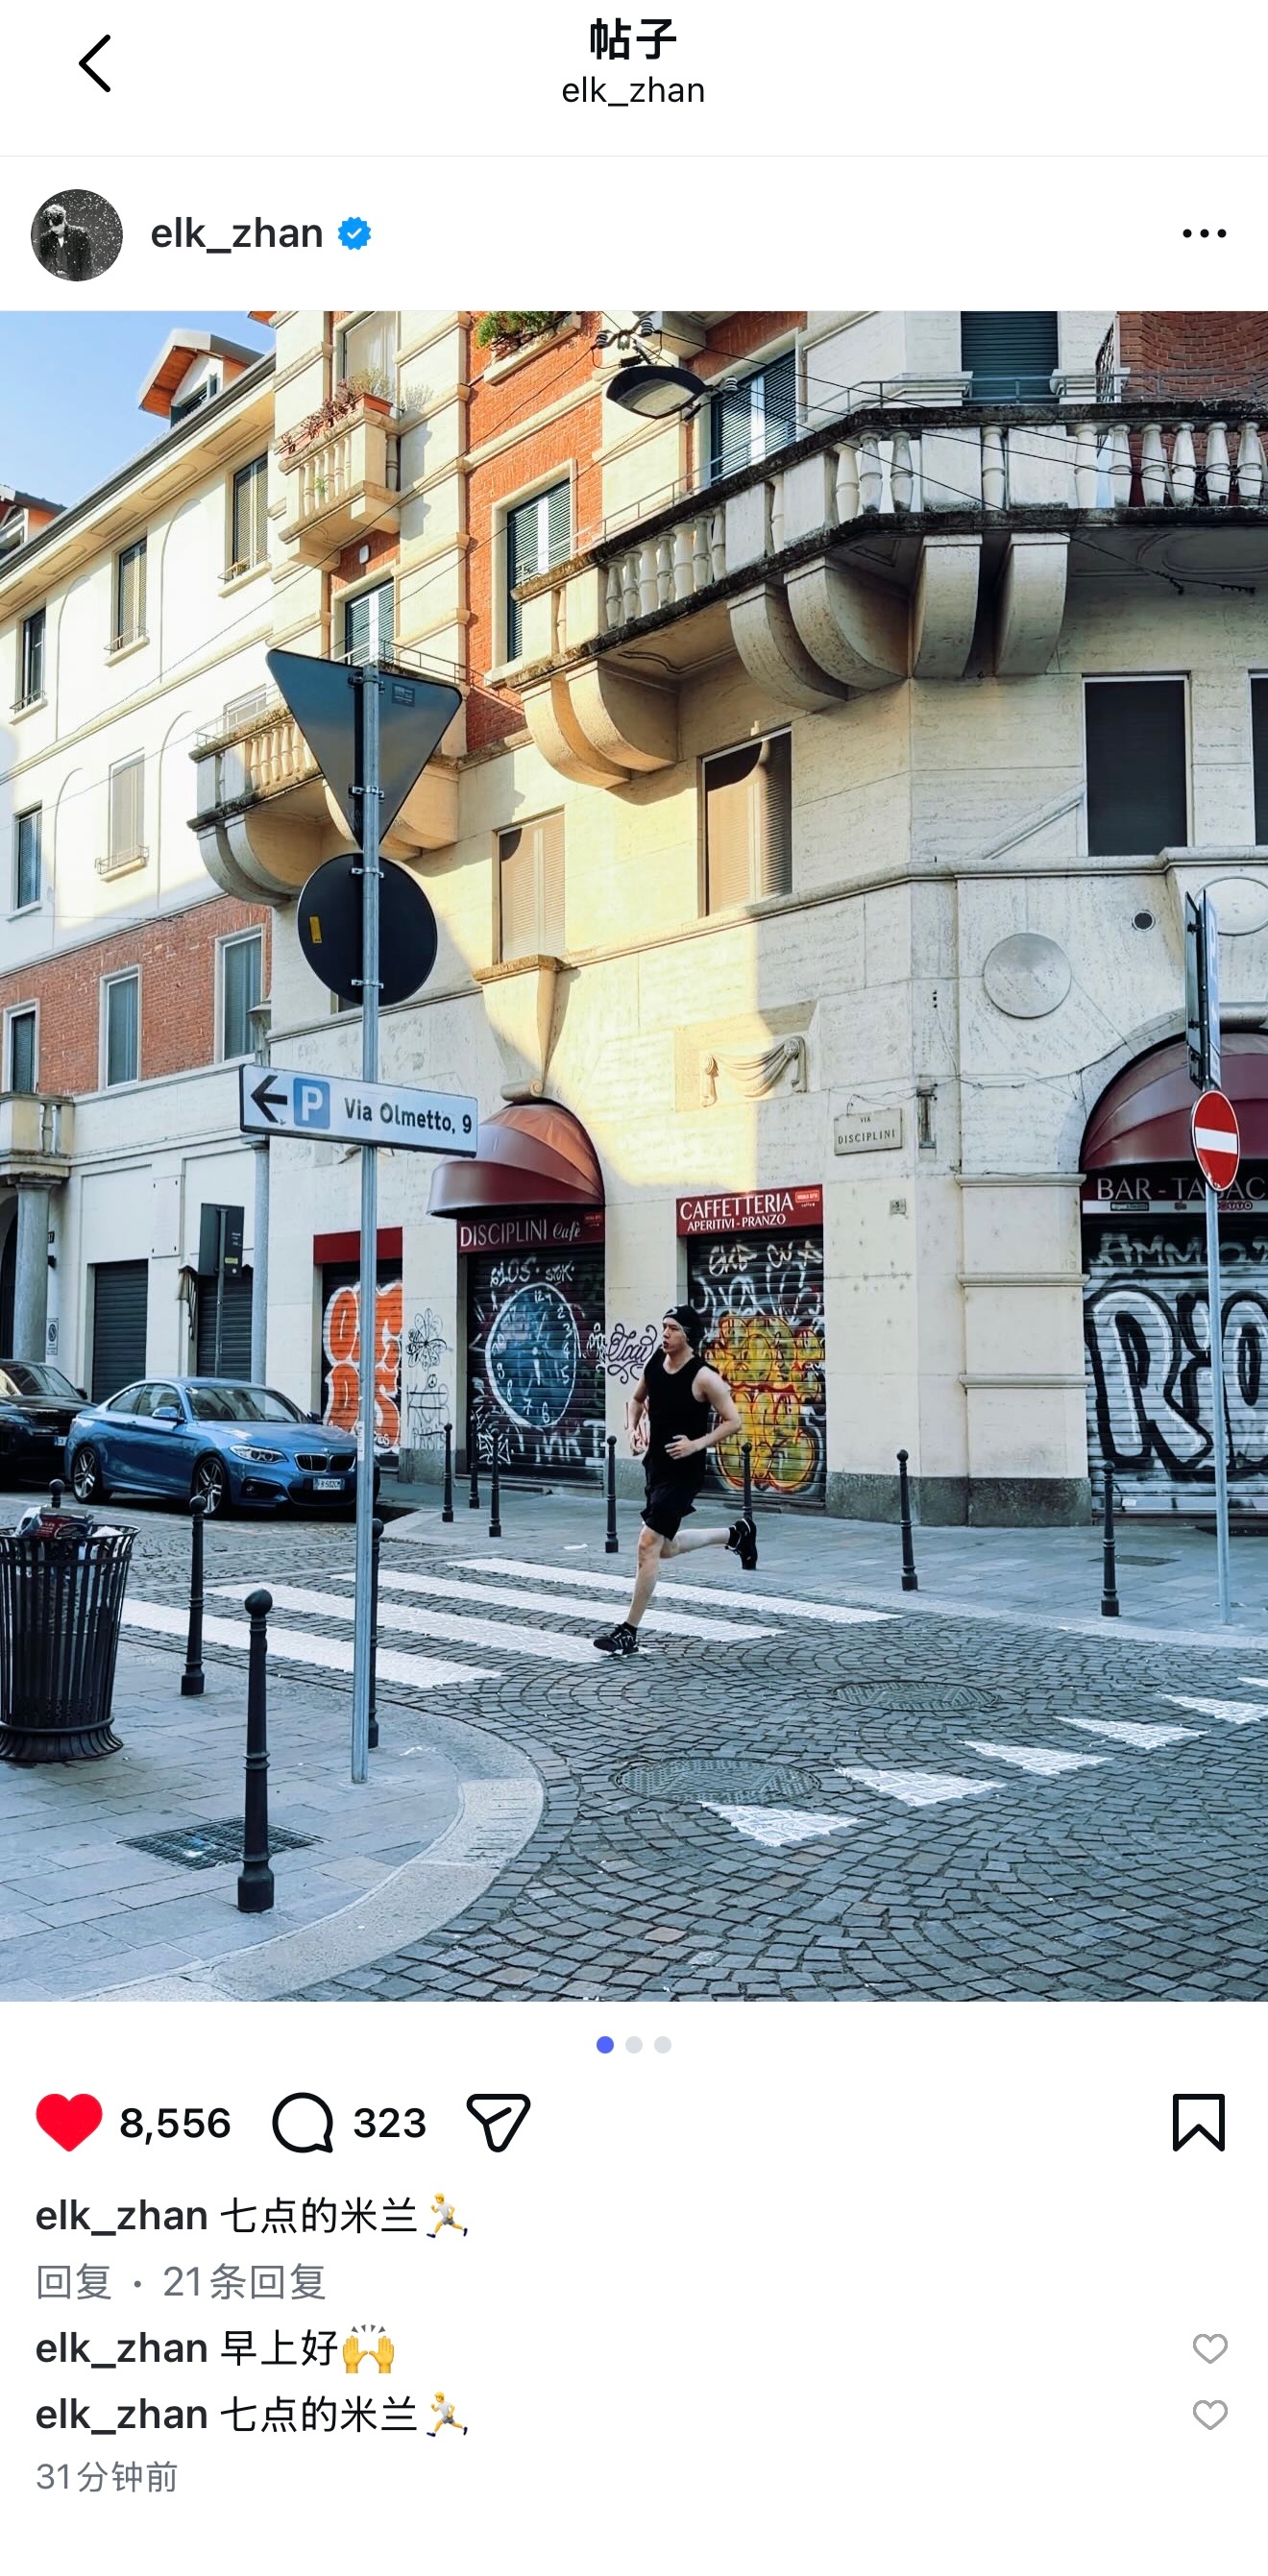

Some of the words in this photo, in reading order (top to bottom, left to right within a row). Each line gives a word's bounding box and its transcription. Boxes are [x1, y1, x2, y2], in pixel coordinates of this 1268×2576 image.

[302, 1086, 323, 1122] P
[345, 1098, 373, 1122] Via
[379, 1103, 455, 1135] Olmetto,
[462, 1114, 473, 1134] 9
[838, 1130, 895, 1145] DISCIPLINI
[1097, 1178, 1152, 1201] BAR
[1170, 1177, 1266, 1201] TAAC
[680, 1193, 794, 1221] CAFFETTERIA
[460, 1219, 548, 1248] DISCIPLINI
[687, 1217, 735, 1232] APERITIVI
[742, 1213, 787, 1228] PRANZO
